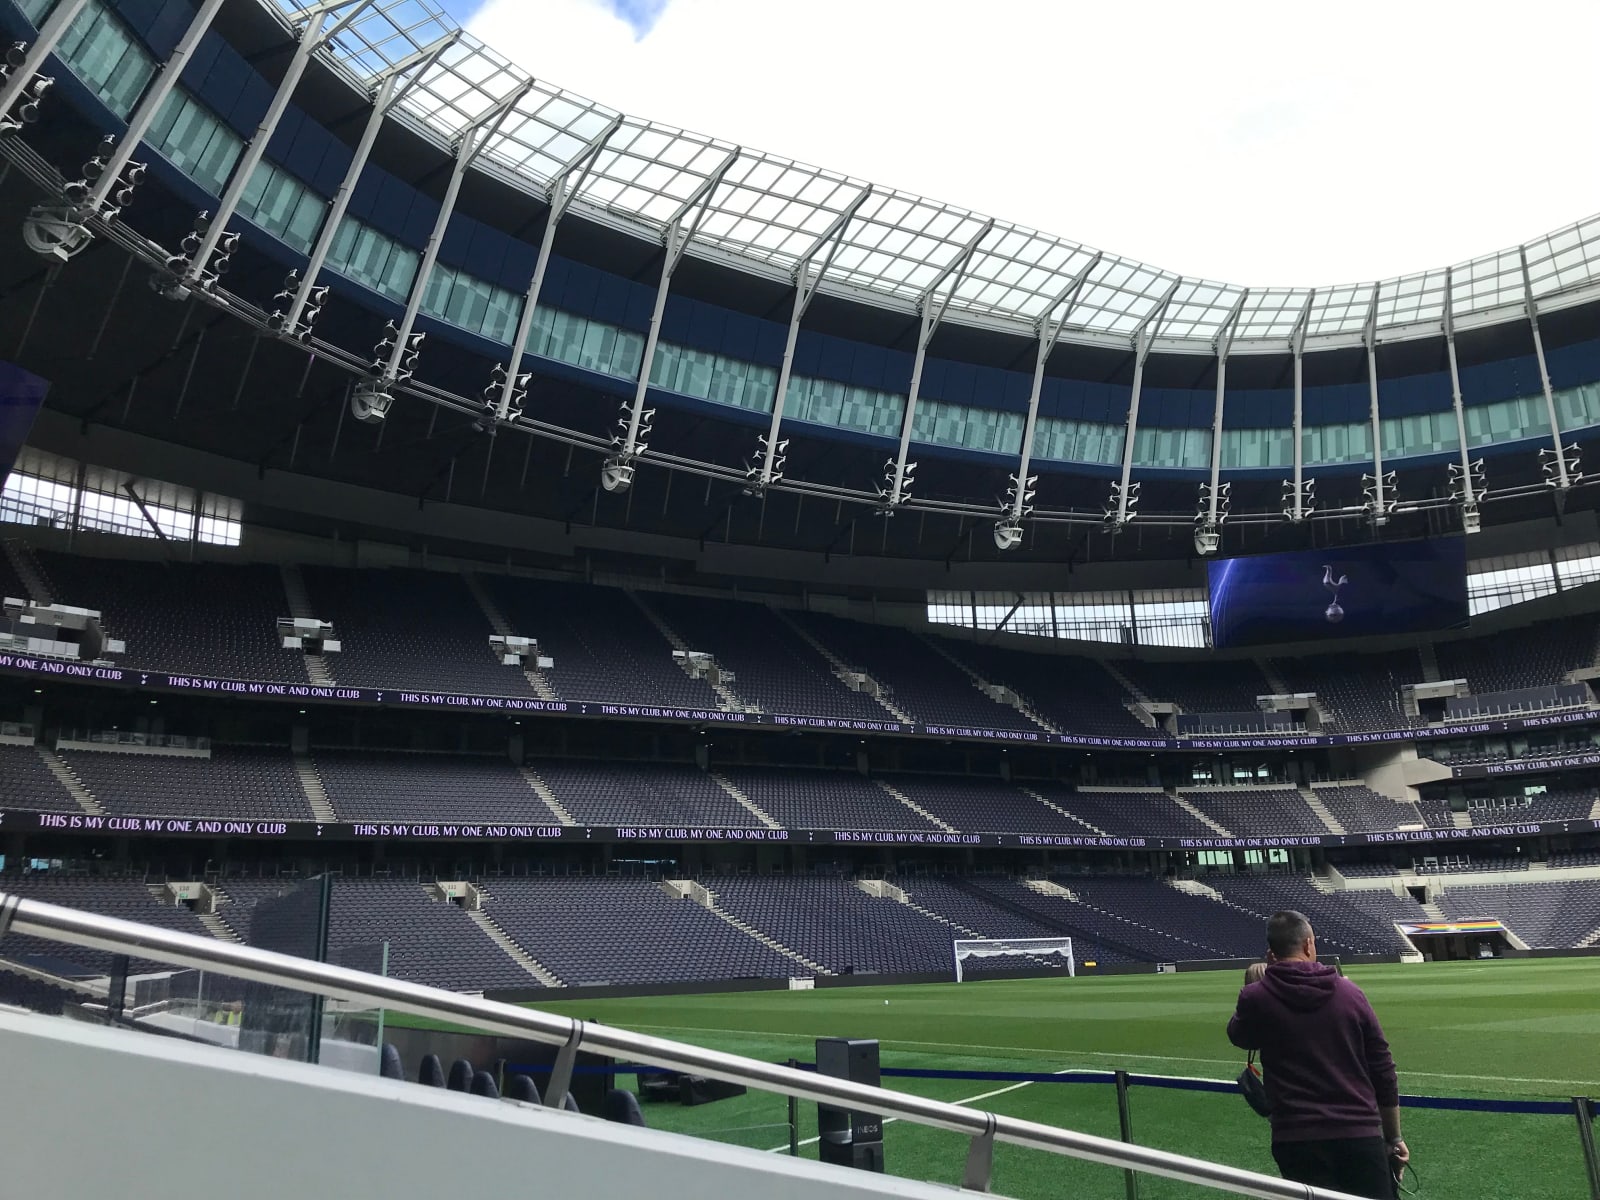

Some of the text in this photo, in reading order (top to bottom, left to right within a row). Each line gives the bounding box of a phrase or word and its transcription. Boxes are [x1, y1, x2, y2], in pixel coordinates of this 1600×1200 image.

[16, 657, 37, 670] ONE
[40, 661, 64, 673] AND
[66, 664, 93, 677] ONLY
[95, 668, 122, 680] CLUB
[169, 676, 190, 687] THIS
[192, 678, 201, 688] IS
[203, 679, 219, 689] MY
[249, 683, 264, 693] MY
[266, 684, 286, 695] ONE
[288, 685, 309, 696] AND
[311, 687, 334, 698] ONLY
[336, 688, 360, 699] CLUB
[401, 693, 420, 703] THIS
[421, 694, 430, 703] IS
[431, 695, 445, 704] MY
[471, 697, 485, 706] MY
[486, 698, 503, 708] ONE
[505, 699, 524, 709] AND
[525, 700, 545, 710] ONLY
[546, 702, 567, 712] CLUB
[602, 705, 619, 714] THIS
[620, 706, 627, 715] IS
[628, 707, 640, 715] MY
[662, 709, 674, 717] MY
[675, 709, 690, 718] ONE
[692, 710, 707, 719] AND
[708, 711, 726, 721] ONLY
[727, 713, 745, 722] CLUB
[1523, 717, 1540, 727] THIS
[1541, 717, 1549, 725] IS
[1549, 716, 1561, 724] MY
[1586, 711, 1598, 719] MY
[774, 716, 789, 725] THIS
[790, 717, 797, 725] IS
[797, 717, 808, 726] MY
[827, 719, 837, 727] MY
[838, 720, 851, 728] ONE
[852, 721, 866, 729] AND
[867, 722, 883, 731] ONLY
[883, 723, 900, 732] CLUB
[926, 726, 939, 734] THIS
[939, 727, 946, 735] IS
[946, 727, 956, 735] MY
[982, 729, 995, 738] ONE
[996, 731, 1008, 739] AND
[1008, 731, 1022, 740] ONLY
[1023, 732, 1038, 741] CLUB
[1347, 734, 1362, 743] THIS
[1370, 733, 1381, 741] MY
[1416, 729, 1432, 737] ONE
[1433, 727, 1449, 736] AND
[1450, 726, 1468, 734] ONLY
[1470, 723, 1490, 732] CLUB
[1123, 739, 1136, 747] AND
[1136, 739, 1150, 747] ONLY
[1151, 740, 1167, 748] CLUB
[1487, 765, 1504, 773] THIS
[1504, 764, 1513, 772] IS
[1513, 763, 1525, 771] MY
[1550, 759, 1562, 768] MY
[1564, 757, 1581, 766] ONE
[1583, 755, 1600, 764] AND
[40, 814, 67, 827] THIS
[70, 815, 82, 828] IS
[85, 816, 106, 829] MY
[145, 819, 164, 831] MY
[167, 819, 192, 832] ONE
[195, 820, 222, 833] AND
[224, 821, 254, 834] ONLY
[256, 822, 286, 835] CLUB
[354, 824, 378, 835] THIS
[380, 824, 390, 836] IS
[393, 825, 409, 836] MY
[443, 826, 459, 836] MY
[462, 826, 482, 837] ONE
[485, 826, 507, 837] AND
[509, 826, 534, 837] ONLY
[536, 827, 561, 837] CLUB
[617, 828, 637, 838] THIS
[638, 828, 647, 838] IS
[649, 828, 663, 838] MY
[690, 829, 703, 839] MY
[705, 829, 723, 839] ONE
[725, 829, 744, 839] AND
[745, 829, 765, 840] ONLY
[767, 830, 789, 840] CLUB
[835, 831, 852, 841] THIS
[852, 831, 860, 841] IS
[861, 832, 873, 841] MY
[896, 833, 908, 842] MY
[909, 833, 924, 843] ONE
[926, 833, 942, 843] AND
[943, 834, 960, 843] ONLY
[962, 834, 981, 844] CLUB
[1019, 835, 1035, 845] THIS
[1035, 836, 1042, 845] IS
[1042, 836, 1053, 845] MY
[1073, 837, 1082, 845] MY
[1084, 837, 1098, 846] ONE
[1098, 837, 1113, 846] AND
[1113, 837, 1128, 846] ONLY
[1129, 838, 1146, 847] CLUB
[1367, 833, 1385, 842] THIS
[1386, 832, 1394, 841] IS
[1395, 832, 1408, 841] MY
[1435, 830, 1449, 839] MY
[1451, 828, 1470, 838] ONE
[1471, 827, 1491, 837] AND
[1492, 826, 1514, 836] ONLY
[1516, 824, 1541, 834] CLUB
[1180, 839, 1195, 847] THIS
[1195, 838, 1202, 847] IS
[1234, 838, 1246, 846] MY
[1247, 838, 1262, 846] ONE
[1263, 838, 1280, 846] AND
[1280, 837, 1299, 846] ONLY
[1301, 836, 1321, 845] CLUB
[858, 1124, 878, 1134] INEOS
